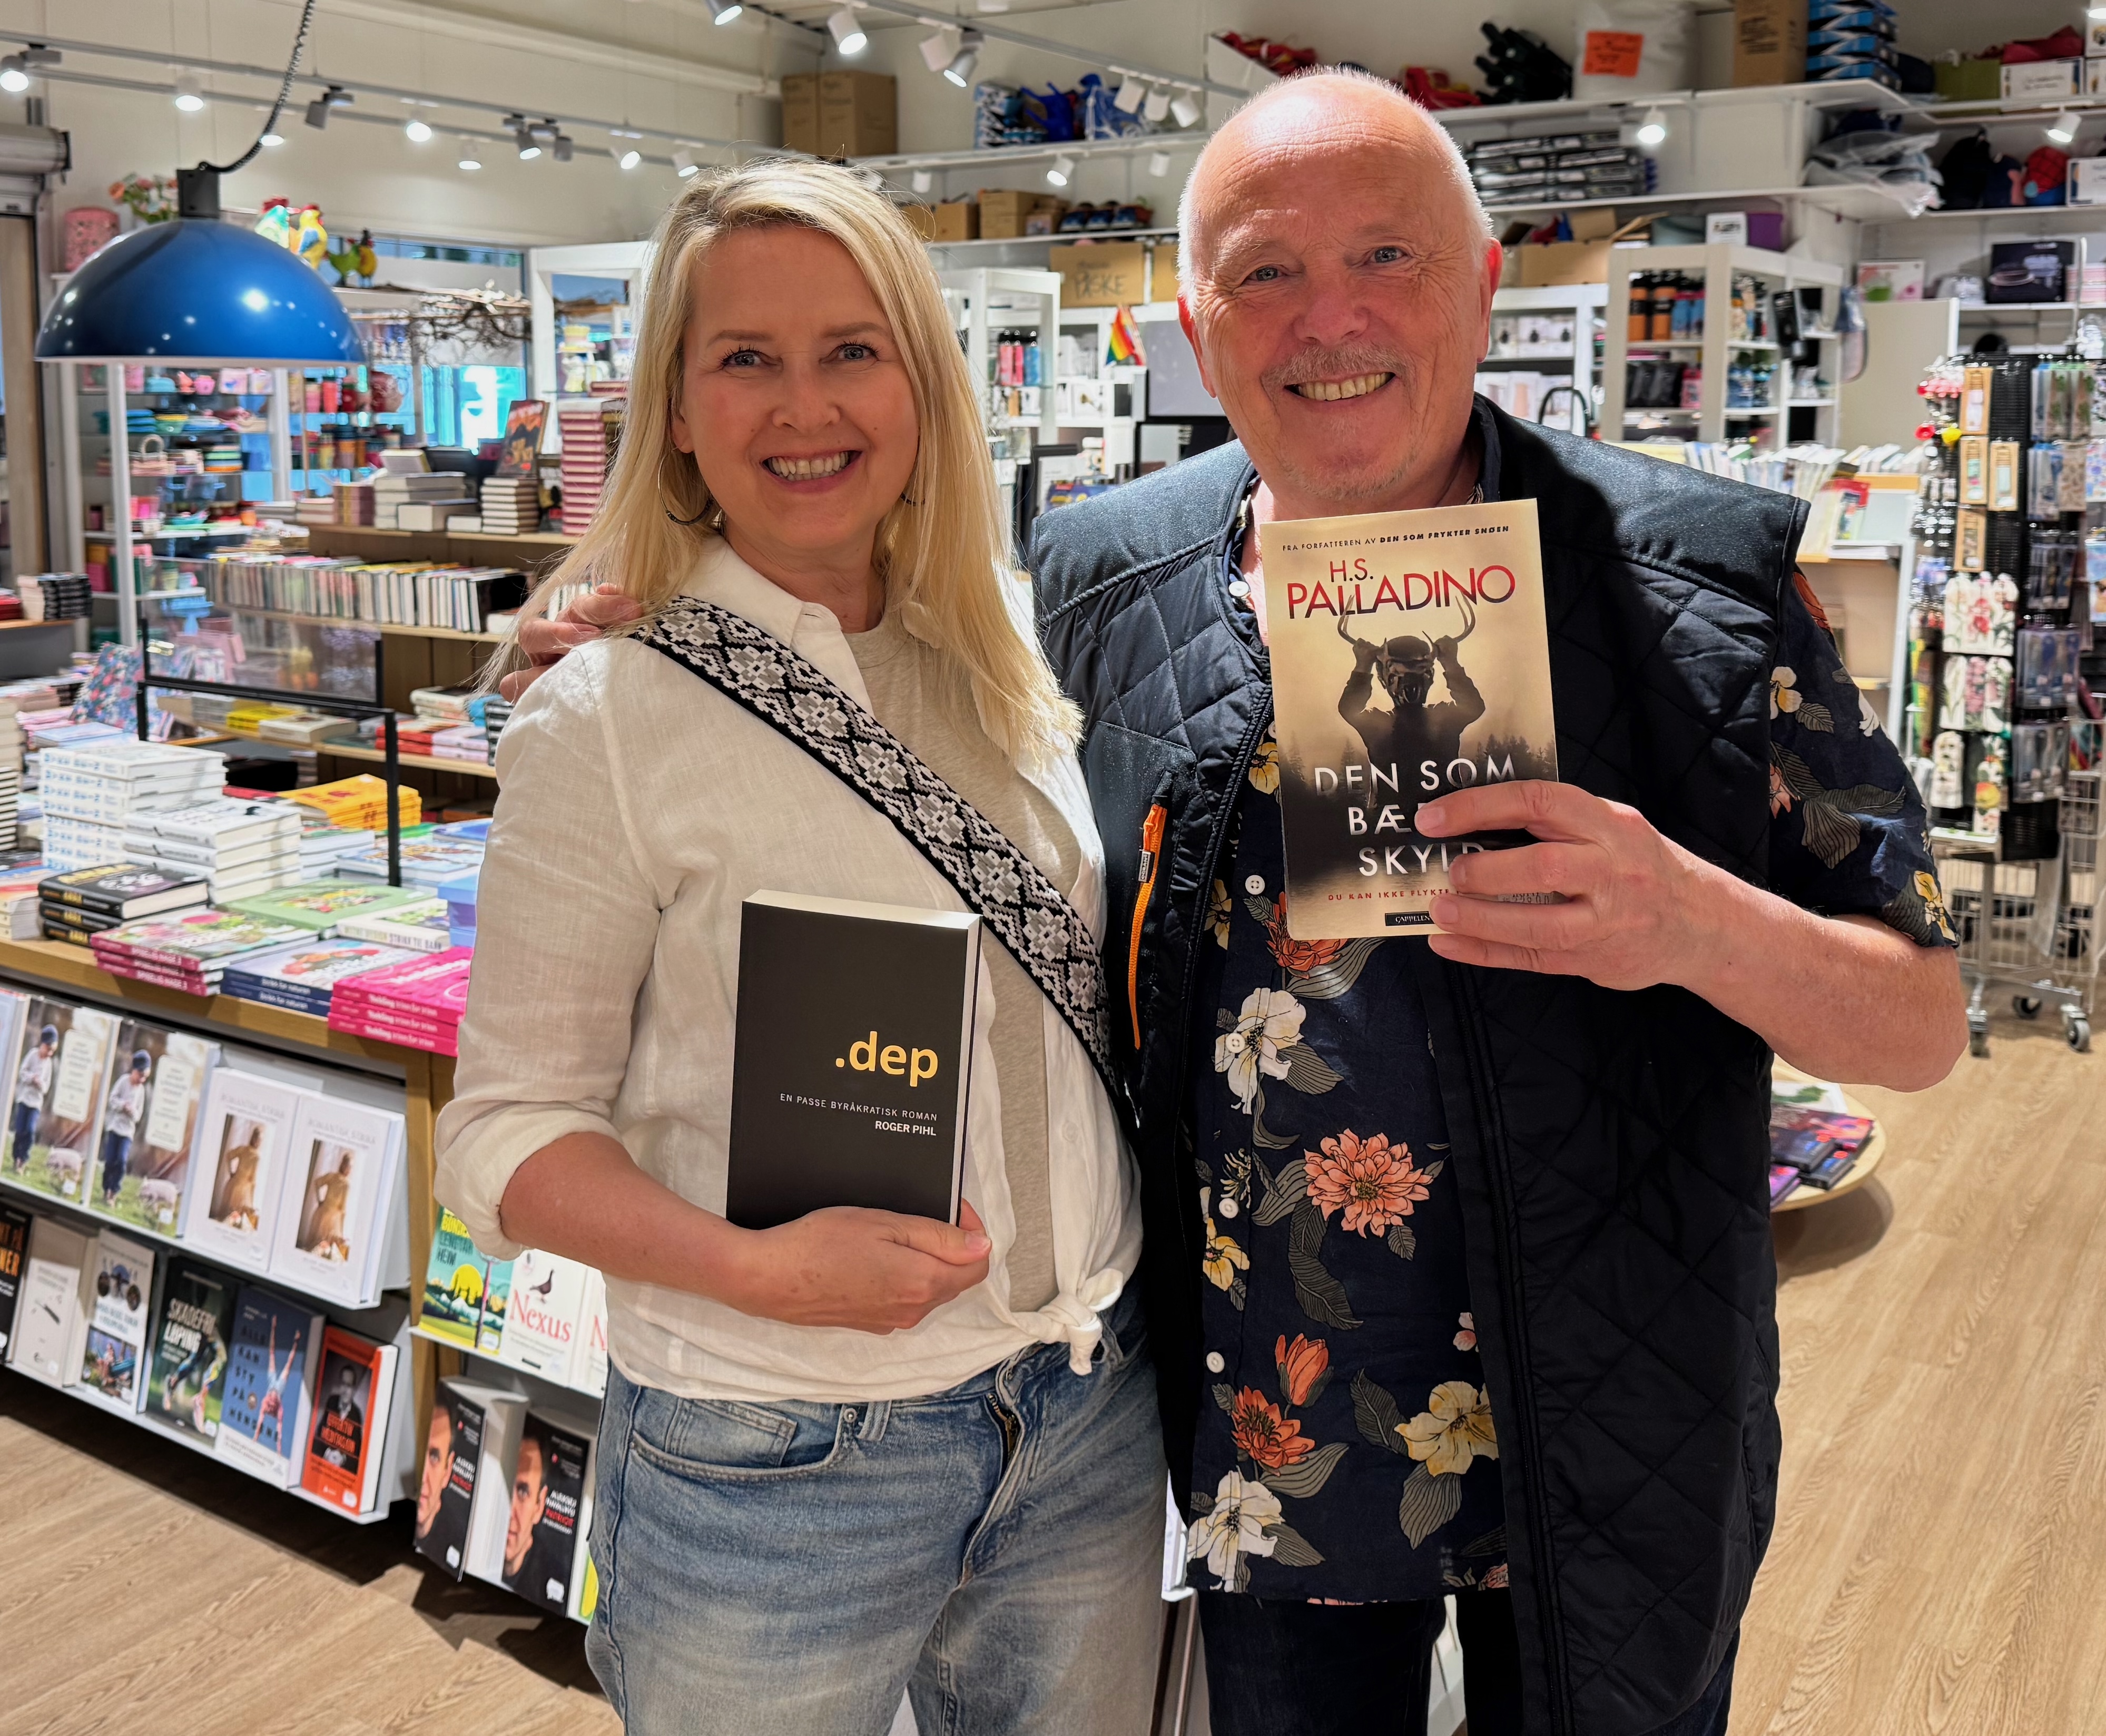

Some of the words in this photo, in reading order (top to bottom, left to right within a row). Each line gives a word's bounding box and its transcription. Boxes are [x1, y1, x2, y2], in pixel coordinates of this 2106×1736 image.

[1302, 539, 1361, 550] FORFATTEREN
[1428, 529, 1471, 539] FRYKTER
[1474, 526, 1509, 535] SNØEN
[1329, 557, 1374, 583] H.S.
[1287, 565, 1516, 619] PALLADINO
[1314, 762, 1399, 794] DEN
[1420, 753, 1515, 790] SOM
[1378, 890, 1405, 899] IKKE
[835, 1030, 939, 1087] .dep
[780, 1093, 792, 1103] EN
[796, 1095, 826, 1107] PASSE
[831, 1101, 898, 1117] BYRÅKRATISK
[902, 1110, 937, 1121] ROMAN
[875, 1120, 910, 1133] ROGER
[912, 1124, 937, 1136] PIHL
[509, 1289, 573, 1343] Nexus
